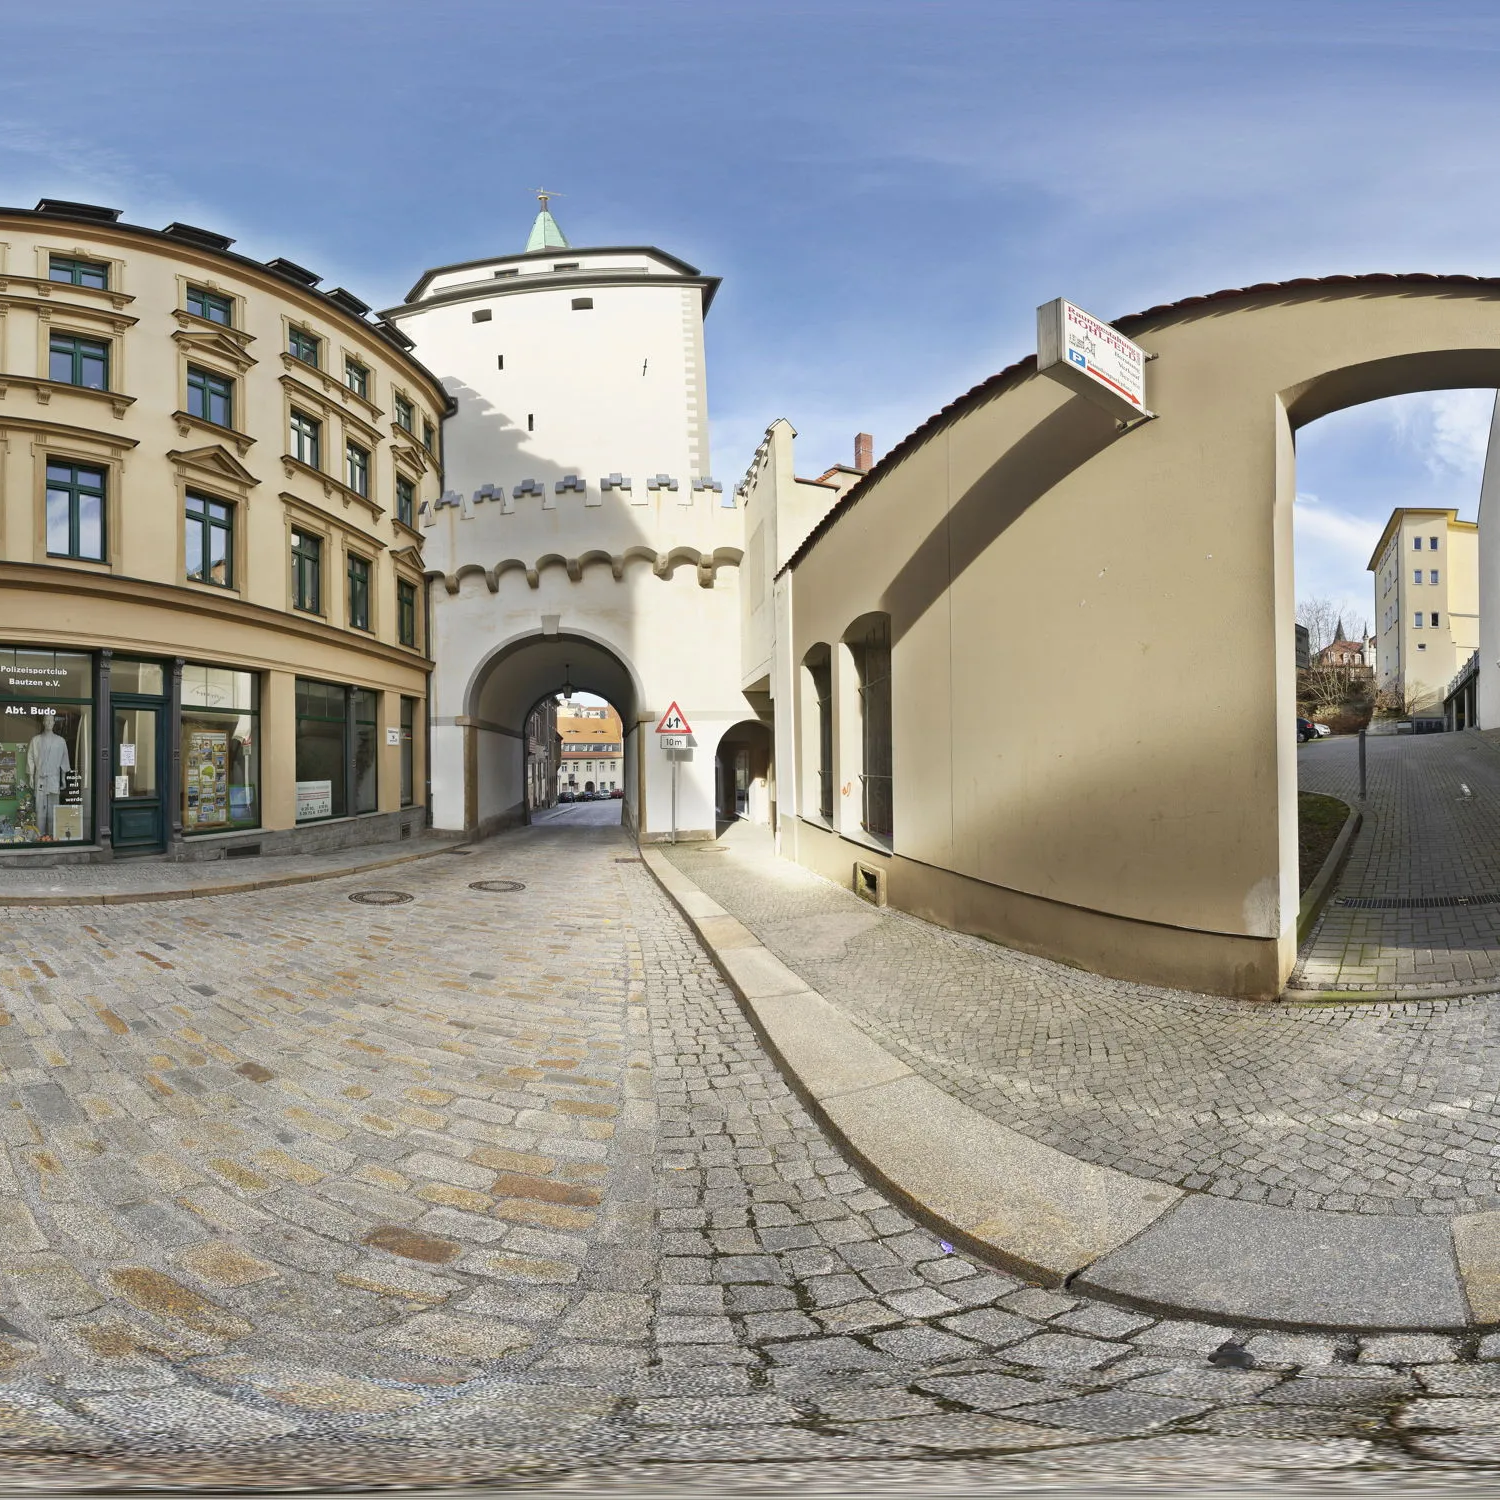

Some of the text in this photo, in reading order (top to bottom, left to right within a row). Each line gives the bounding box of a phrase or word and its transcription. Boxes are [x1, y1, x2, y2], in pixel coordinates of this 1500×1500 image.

[1068, 305, 1136, 356] Raumgestaltung
[1067, 313, 1137, 362] HOHLFELD
[1072, 351, 1083, 361] P
[0, 665, 68, 676] Polizeisportclub
[9, 678, 43, 686] Bautzen
[5, 706, 57, 716] Abt. Budo
